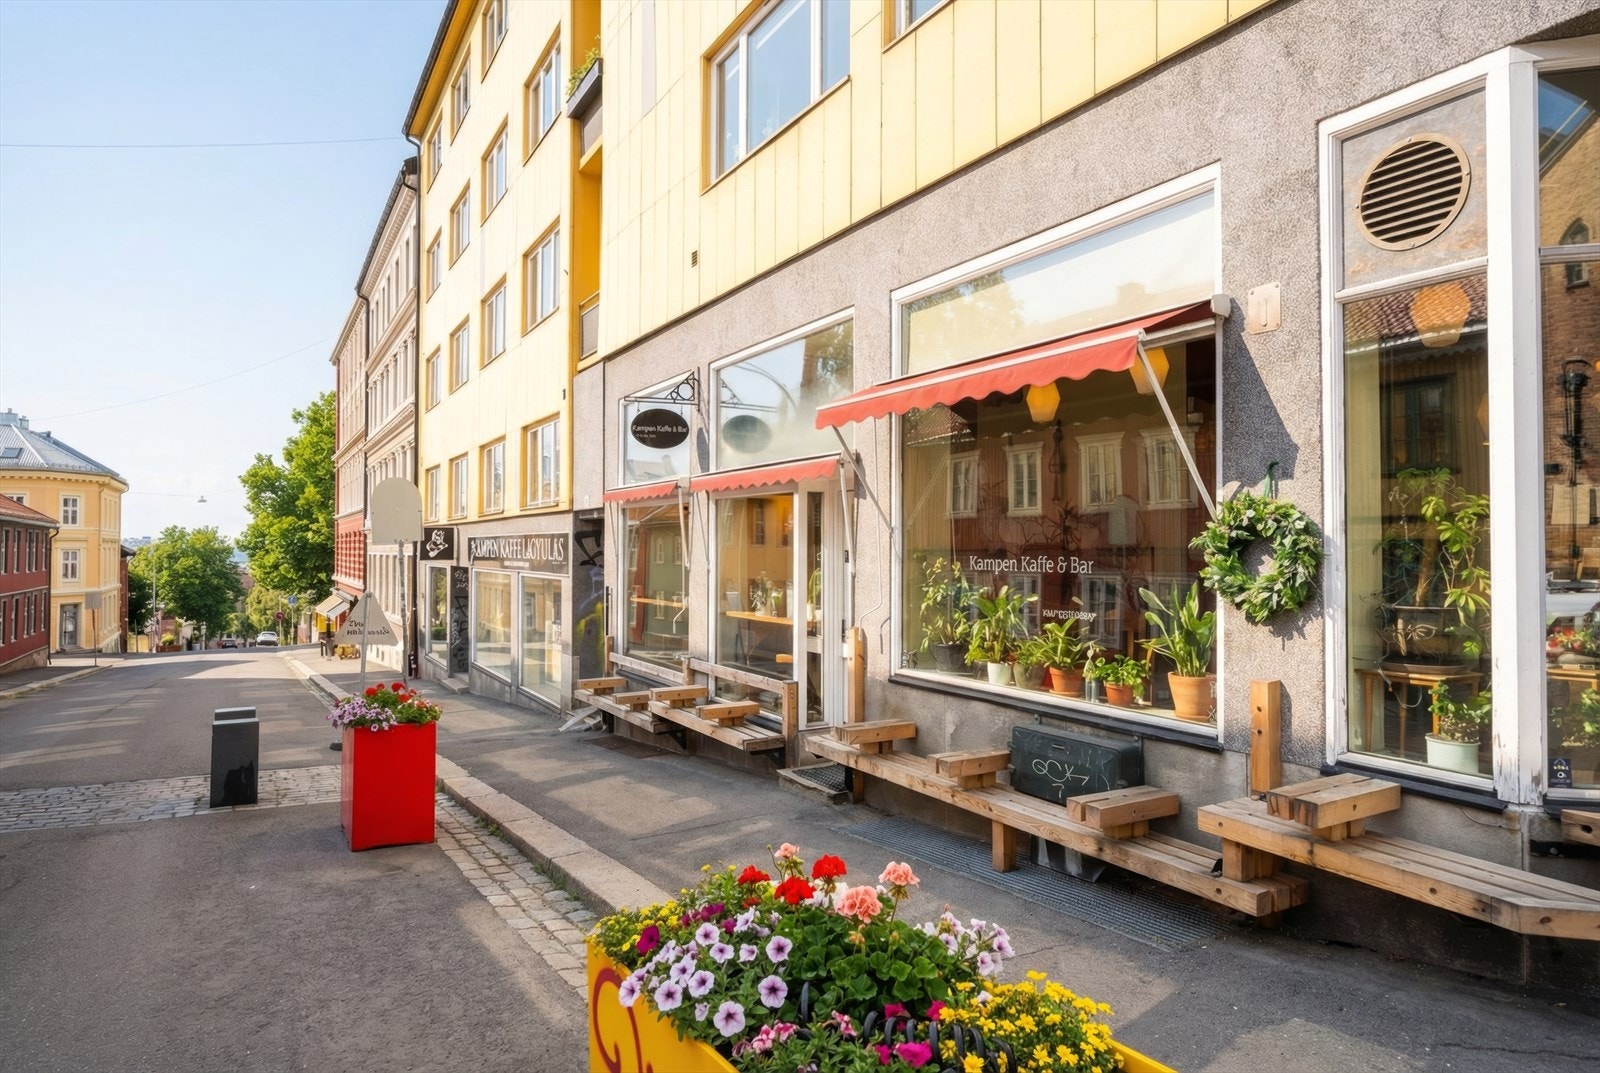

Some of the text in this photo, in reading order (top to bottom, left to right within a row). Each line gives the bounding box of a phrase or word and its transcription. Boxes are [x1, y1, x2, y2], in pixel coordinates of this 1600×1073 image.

[500, 538, 522, 559] KAFFE
[969, 555, 1094, 574] Kampen Kaffe & Bar
